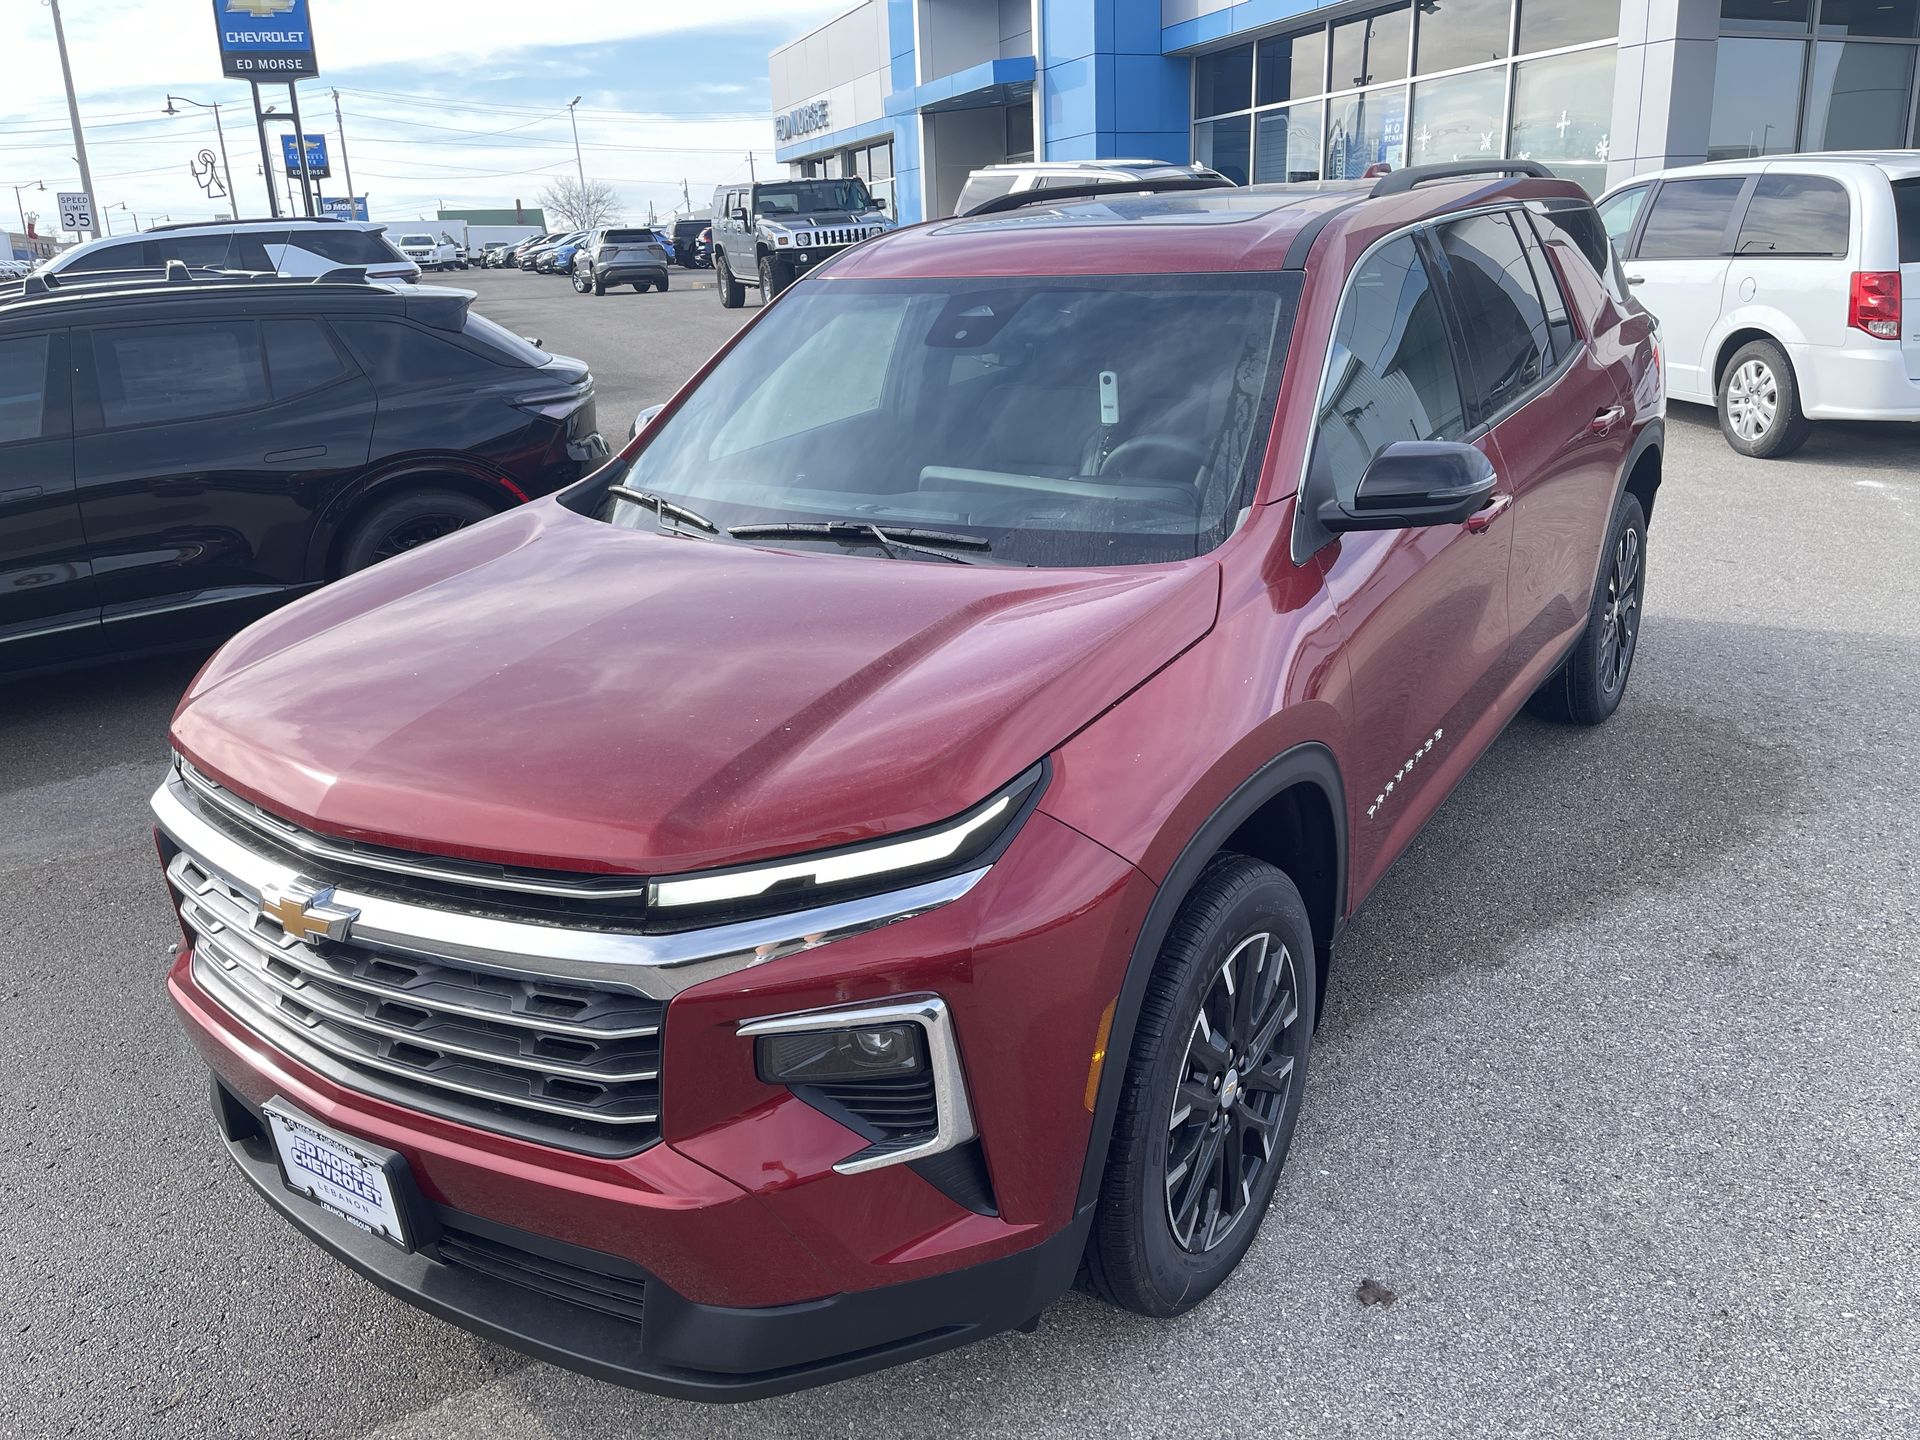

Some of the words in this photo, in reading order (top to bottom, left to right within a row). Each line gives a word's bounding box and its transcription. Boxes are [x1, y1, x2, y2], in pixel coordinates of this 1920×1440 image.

[226, 32, 304, 43] CHEVROLET
[236, 59, 253, 69] ED
[258, 59, 303, 69] MORSE
[790, 100, 829, 135] MORSE
[64, 213, 90, 227] 35
[291, 1147, 382, 1207] CHEVROLET
[294, 1136, 317, 1158] ED
[316, 1145, 375, 1186] MORSE
[317, 1181, 371, 1214] LEBANON
